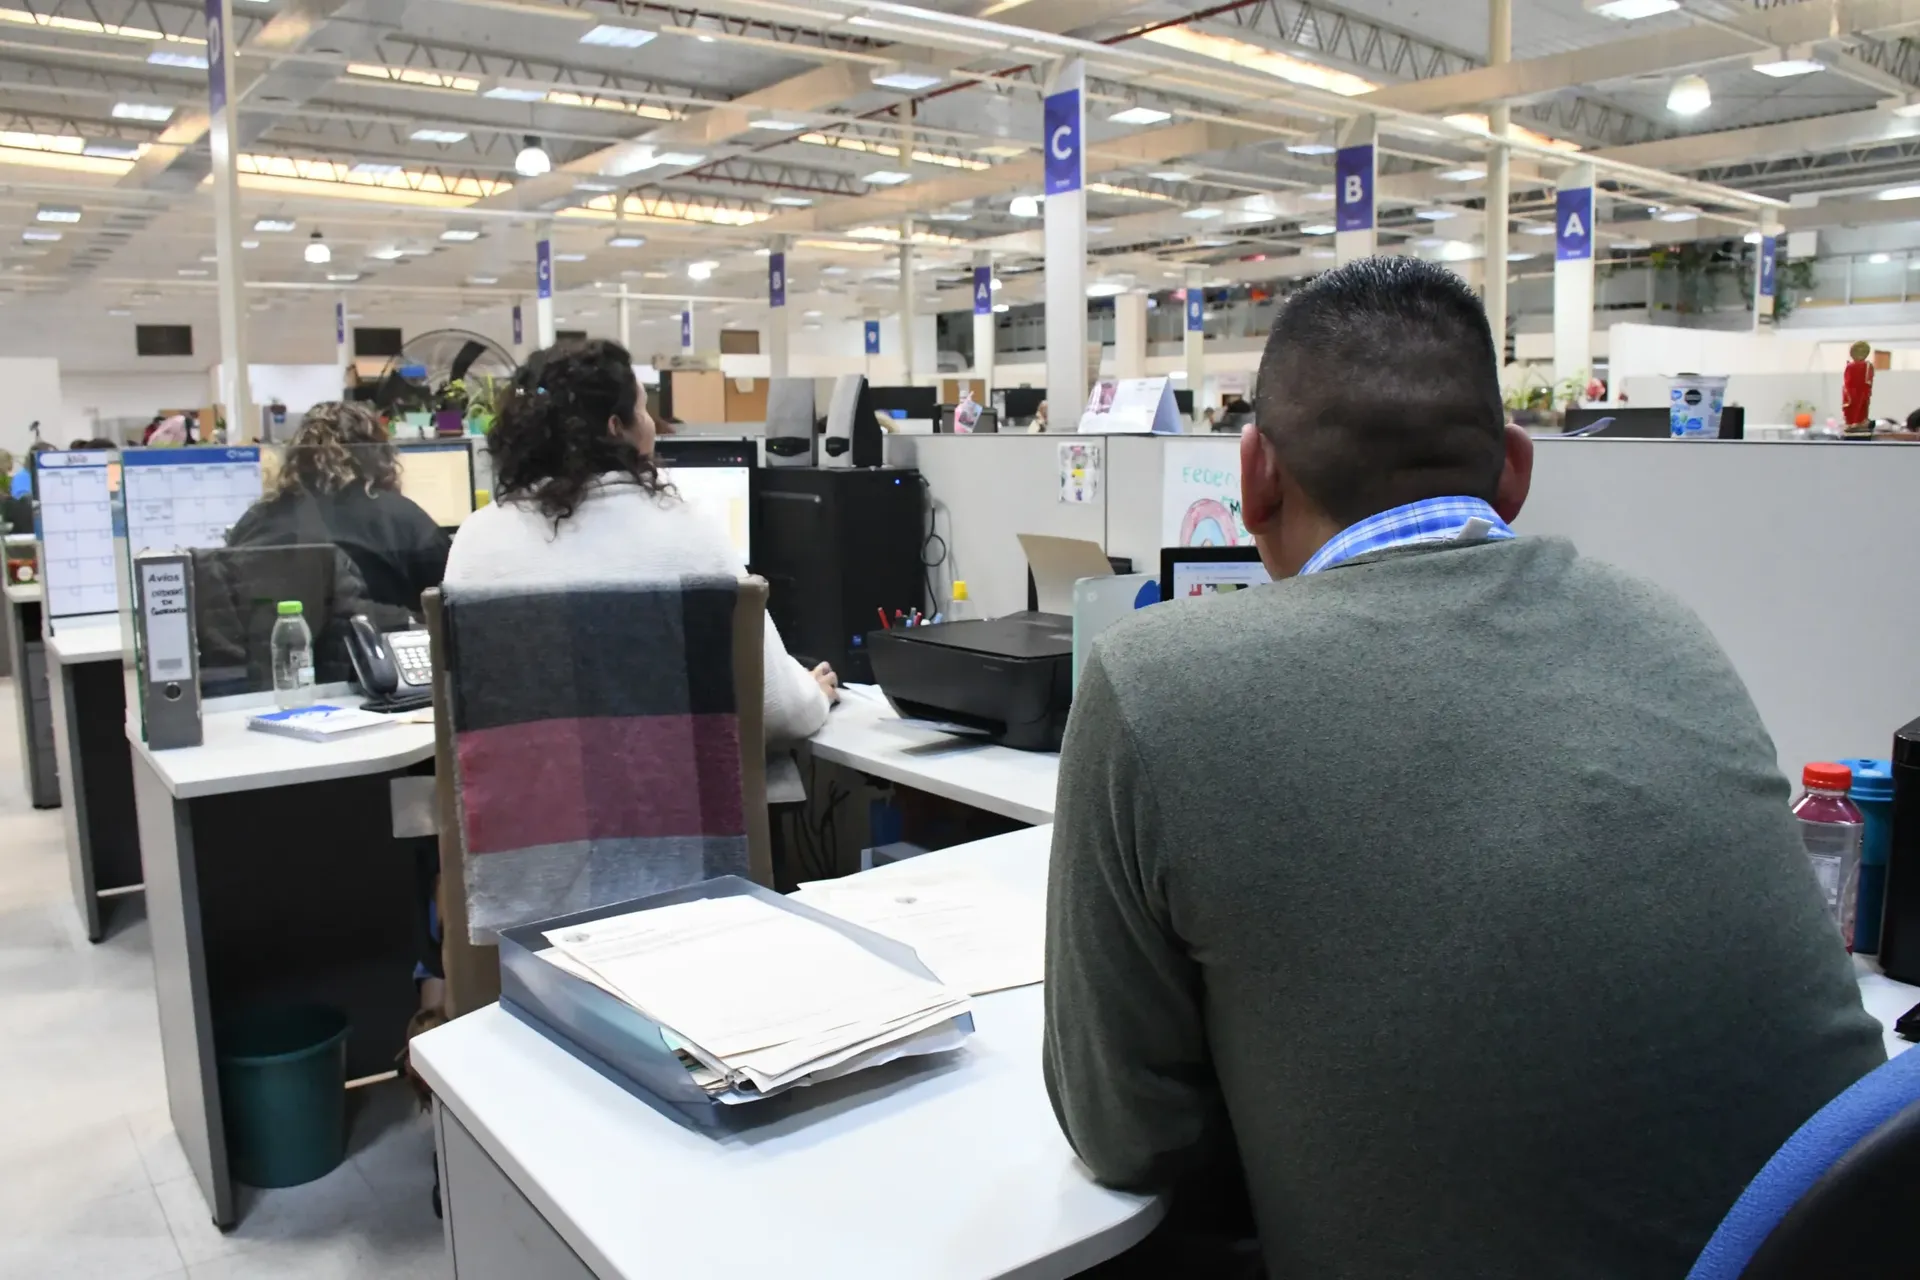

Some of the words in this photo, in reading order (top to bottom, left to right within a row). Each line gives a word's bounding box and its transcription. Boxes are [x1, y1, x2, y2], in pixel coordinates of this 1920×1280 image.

[1051, 125, 1072, 160] C
[1344, 174, 1363, 204] B
[1563, 211, 1585, 237] A
[539, 259, 549, 281] C
[1763, 255, 1772, 276] 7
[976, 282, 988, 299] A
